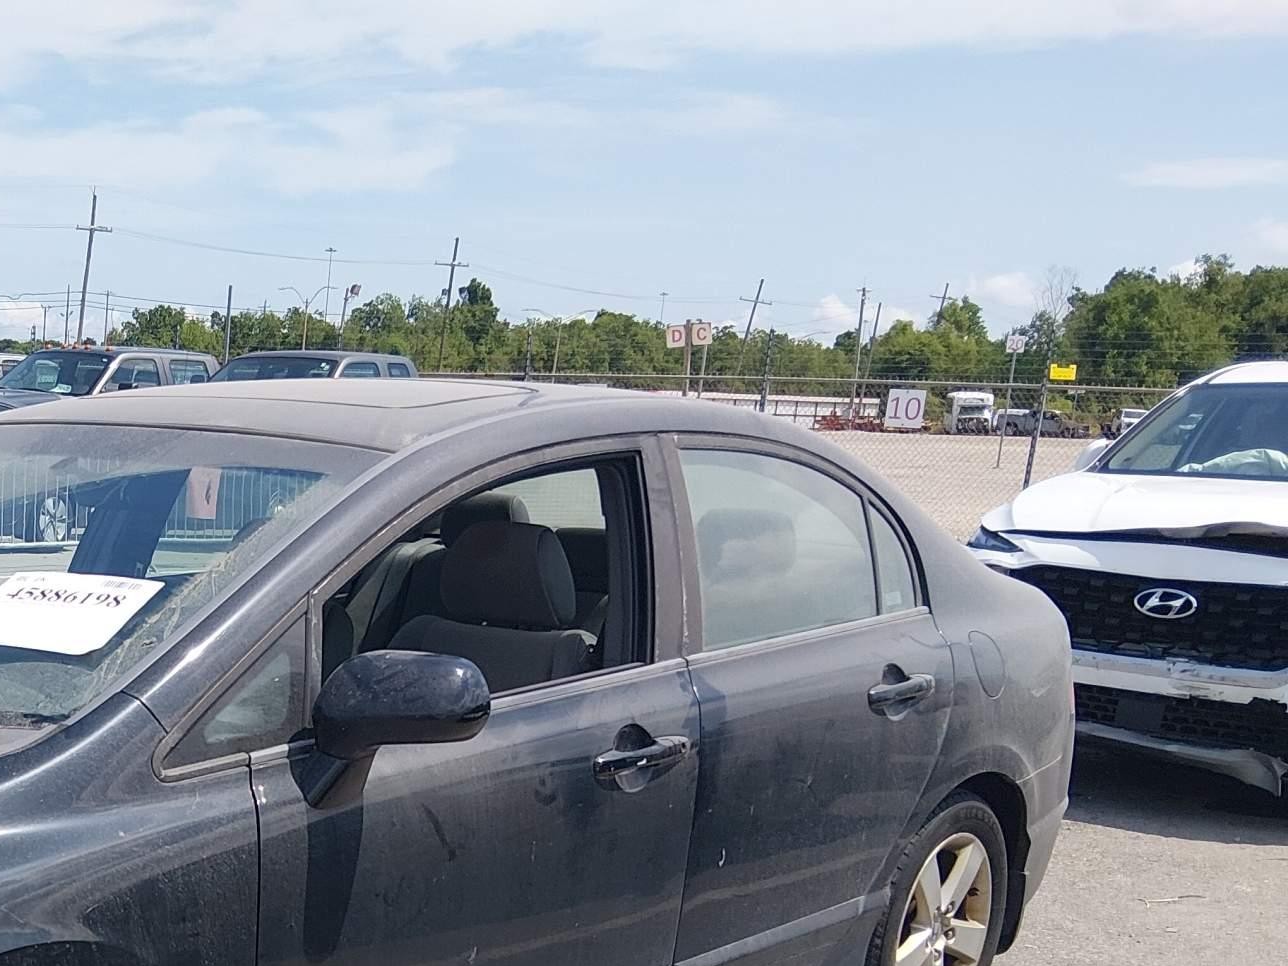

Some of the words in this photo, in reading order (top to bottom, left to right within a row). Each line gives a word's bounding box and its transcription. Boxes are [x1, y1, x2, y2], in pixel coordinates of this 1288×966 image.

[672, 329, 683, 343] D
[696, 327, 707, 341] C
[888, 396, 921, 420] 10
[6, 586, 127, 608] 45886198
